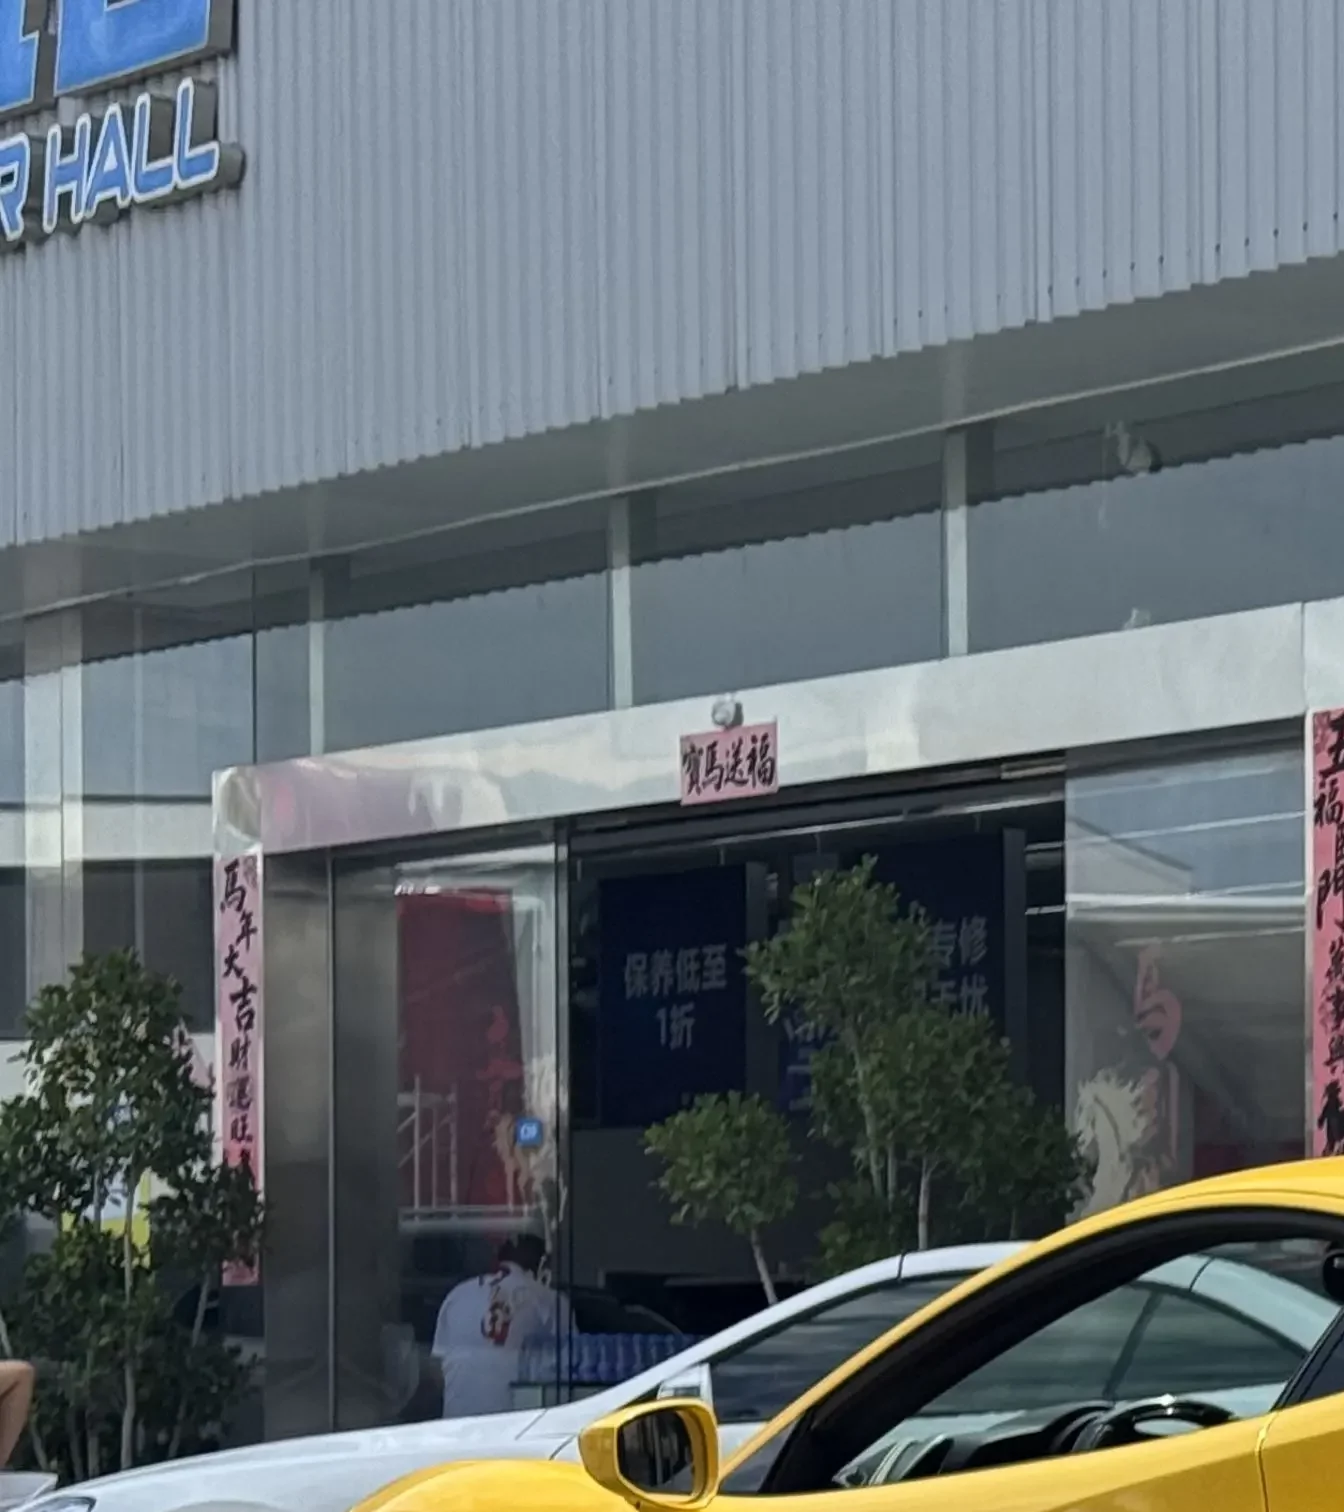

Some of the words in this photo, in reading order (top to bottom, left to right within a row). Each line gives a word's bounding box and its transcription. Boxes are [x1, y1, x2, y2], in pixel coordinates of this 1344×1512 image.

[43, 77, 220, 234] HALL
[624, 943, 727, 1000] 保养低至
[656, 1001, 696, 1050] 1折
